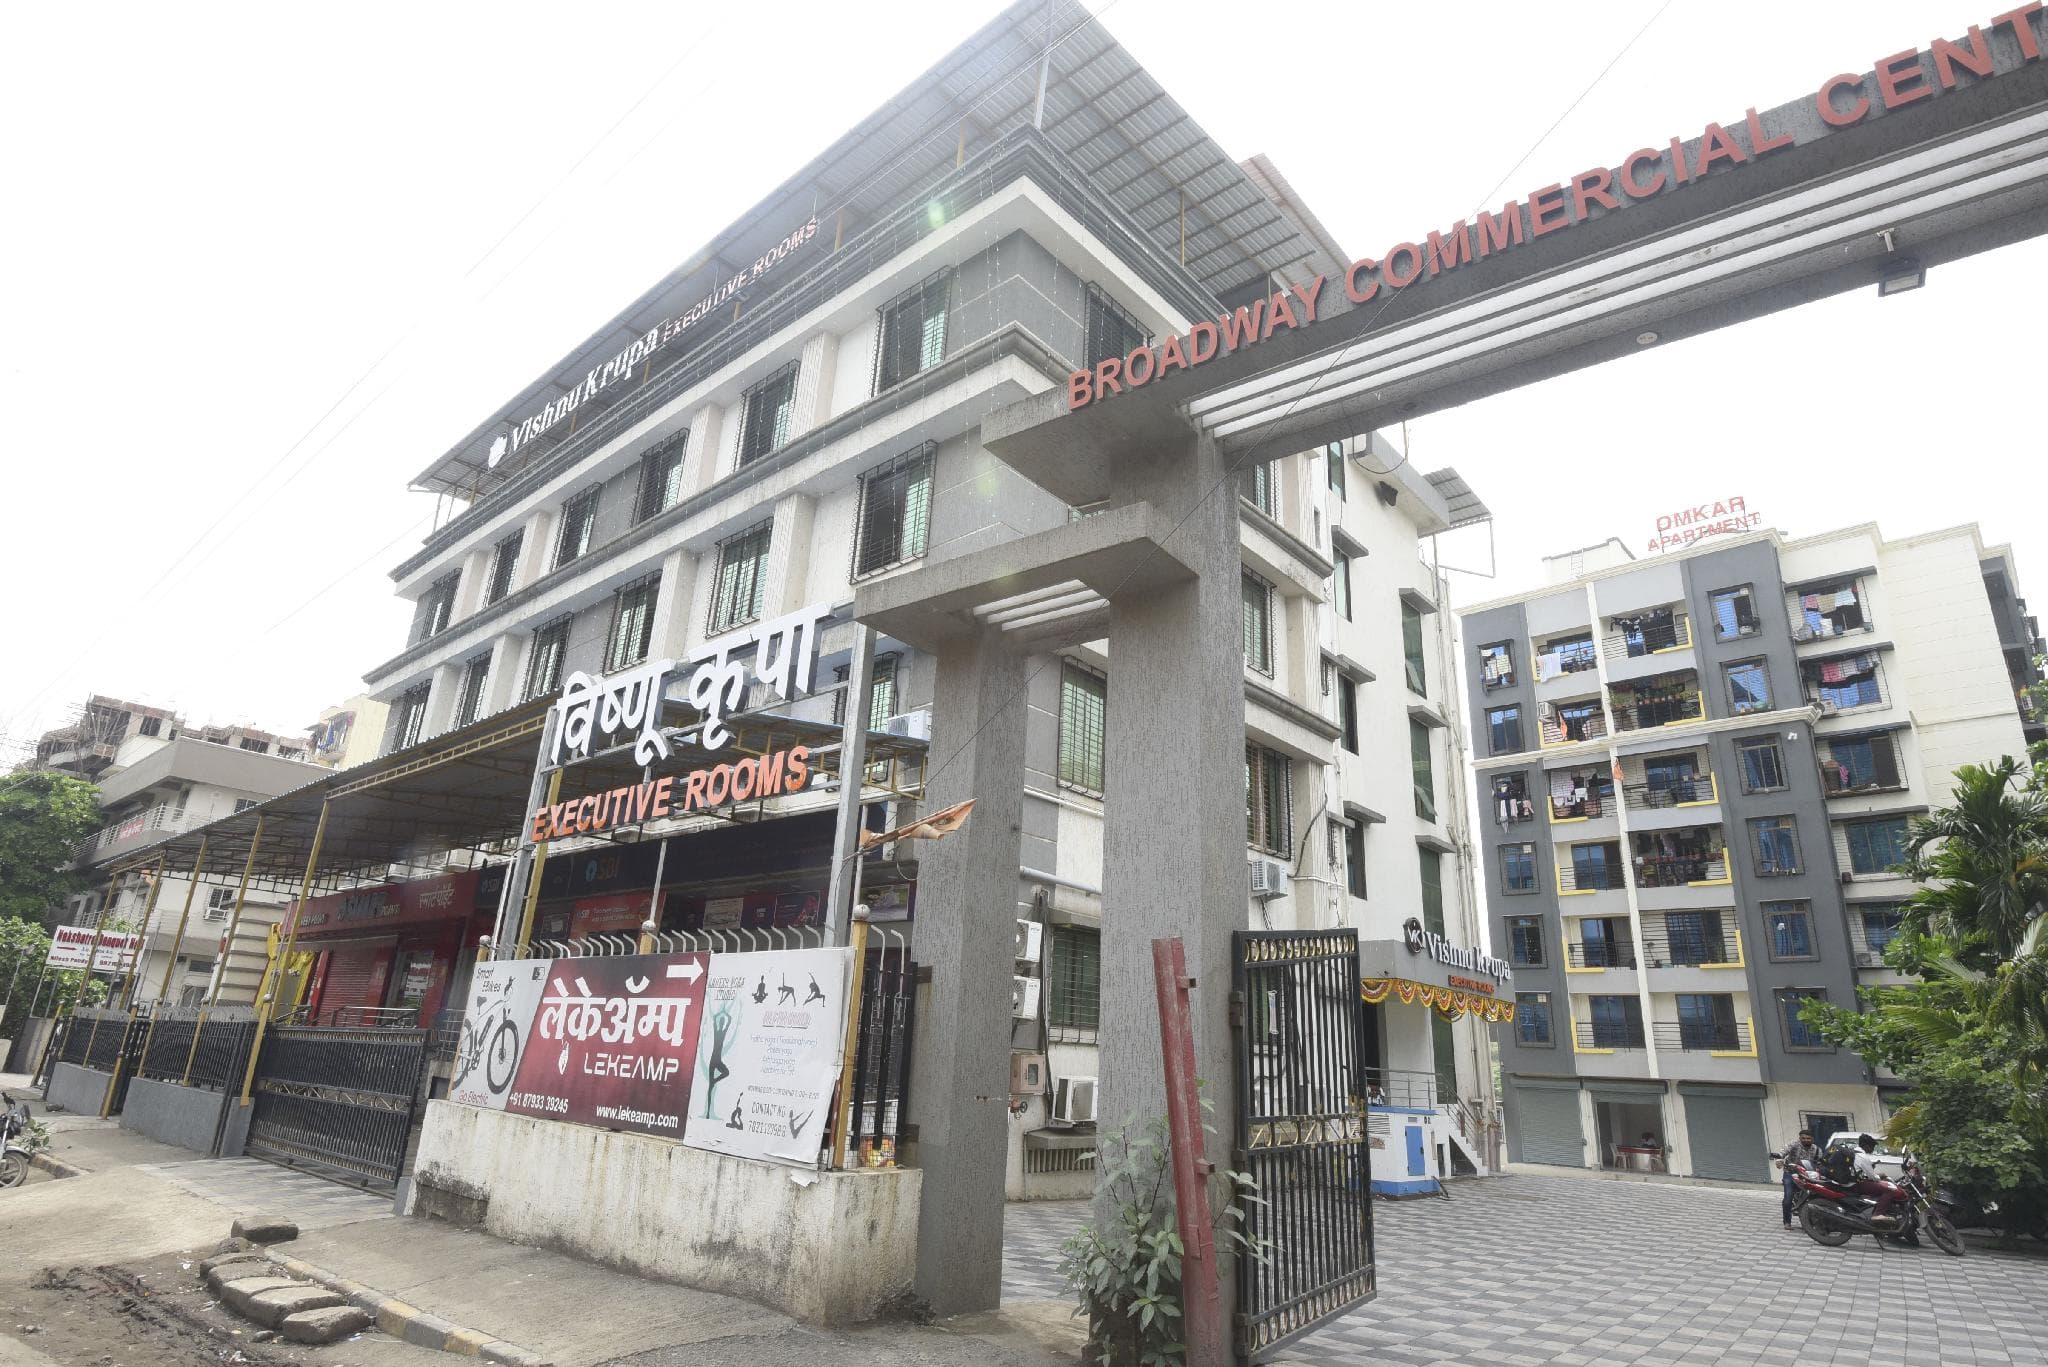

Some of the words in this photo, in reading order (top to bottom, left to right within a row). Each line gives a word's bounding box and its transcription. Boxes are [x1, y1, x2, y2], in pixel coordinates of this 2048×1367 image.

[1068, 273, 1327, 409] BROADWAY
[1345, 106, 1794, 303] COMMERCIAL
[512, 384, 583, 451] Vishnu
[583, 328, 658, 402] Krupa
[662, 271, 748, 342] EXECUTIVE
[751, 218, 817, 275] ROOMS
[1648, 511, 1762, 552] APARTMENT
[1656, 496, 1744, 532] OMKAR
[688, 600, 832, 750] कृपा
[532, 777, 675, 842] EXECUTIVE
[684, 746, 809, 811] ROOMS
[584, 1052, 679, 1081] LEKEAMP
[510, 1092, 521, 1105] +91
[523, 1093, 544, 1109] 87933
[546, 1096, 568, 1113] 39245
[596, 1105, 678, 1128] www.lekeamp.com
